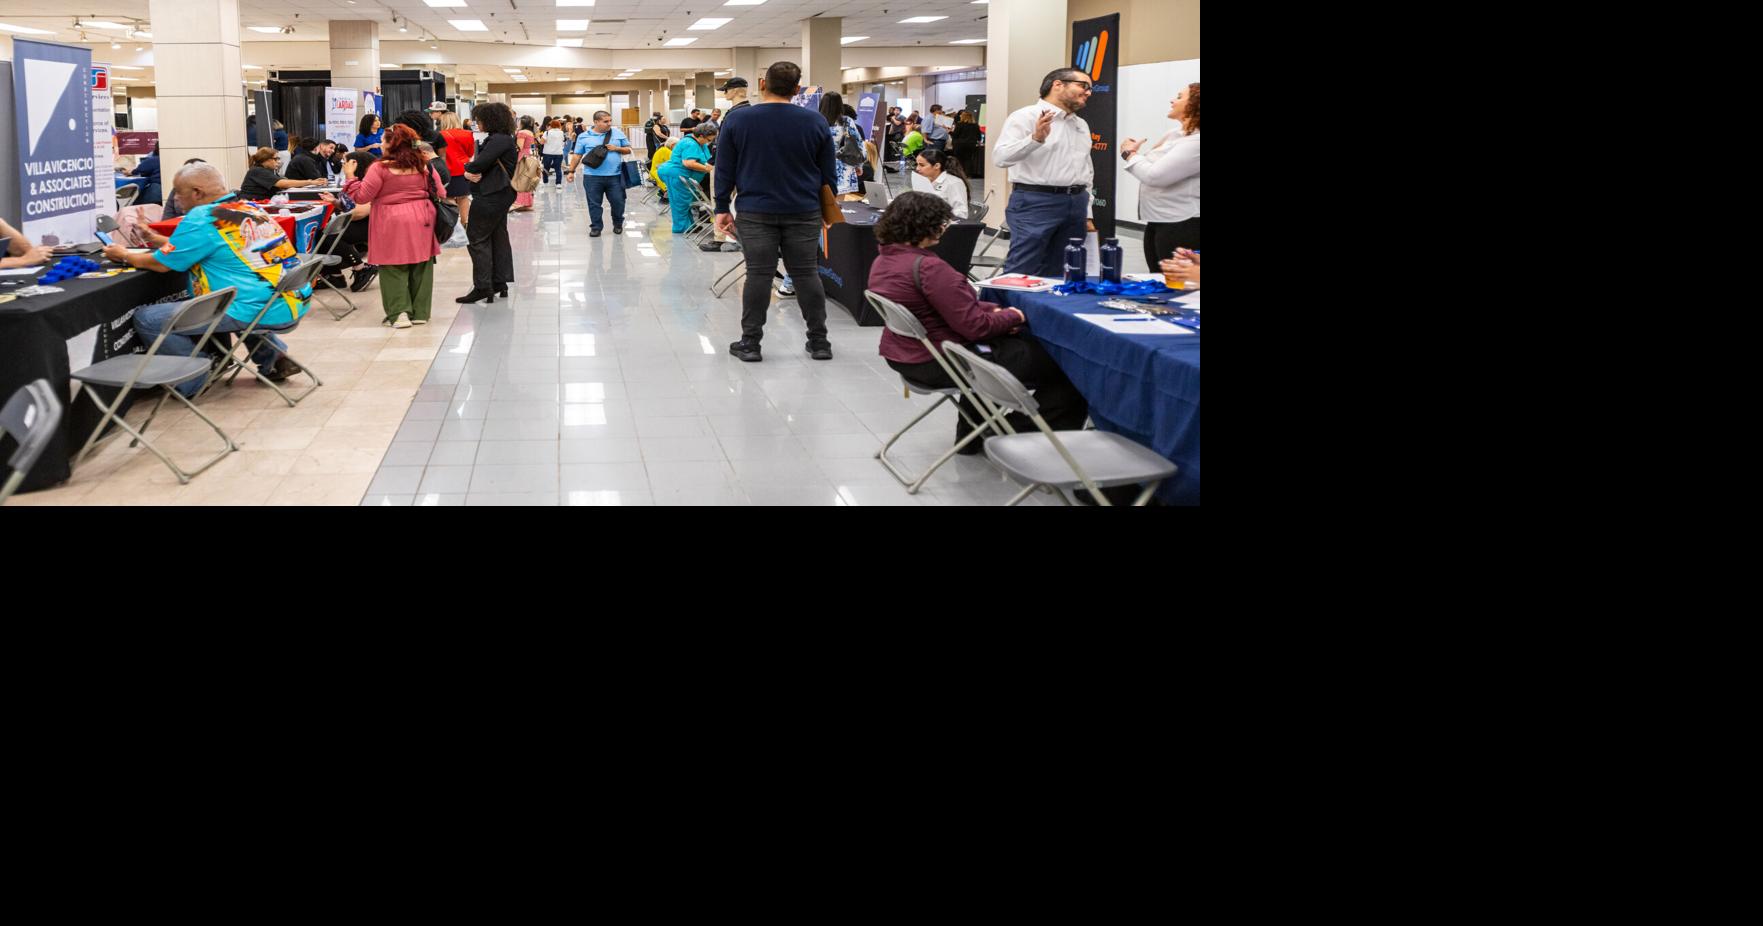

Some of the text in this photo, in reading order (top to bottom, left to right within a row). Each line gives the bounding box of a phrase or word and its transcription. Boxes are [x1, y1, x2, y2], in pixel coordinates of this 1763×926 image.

[24, 157, 93, 176] VILLAVICENCIO
[30, 182, 38, 196] &
[39, 175, 92, 193] ASSOCIATES
[26, 192, 95, 215] CONSTRUCTION
